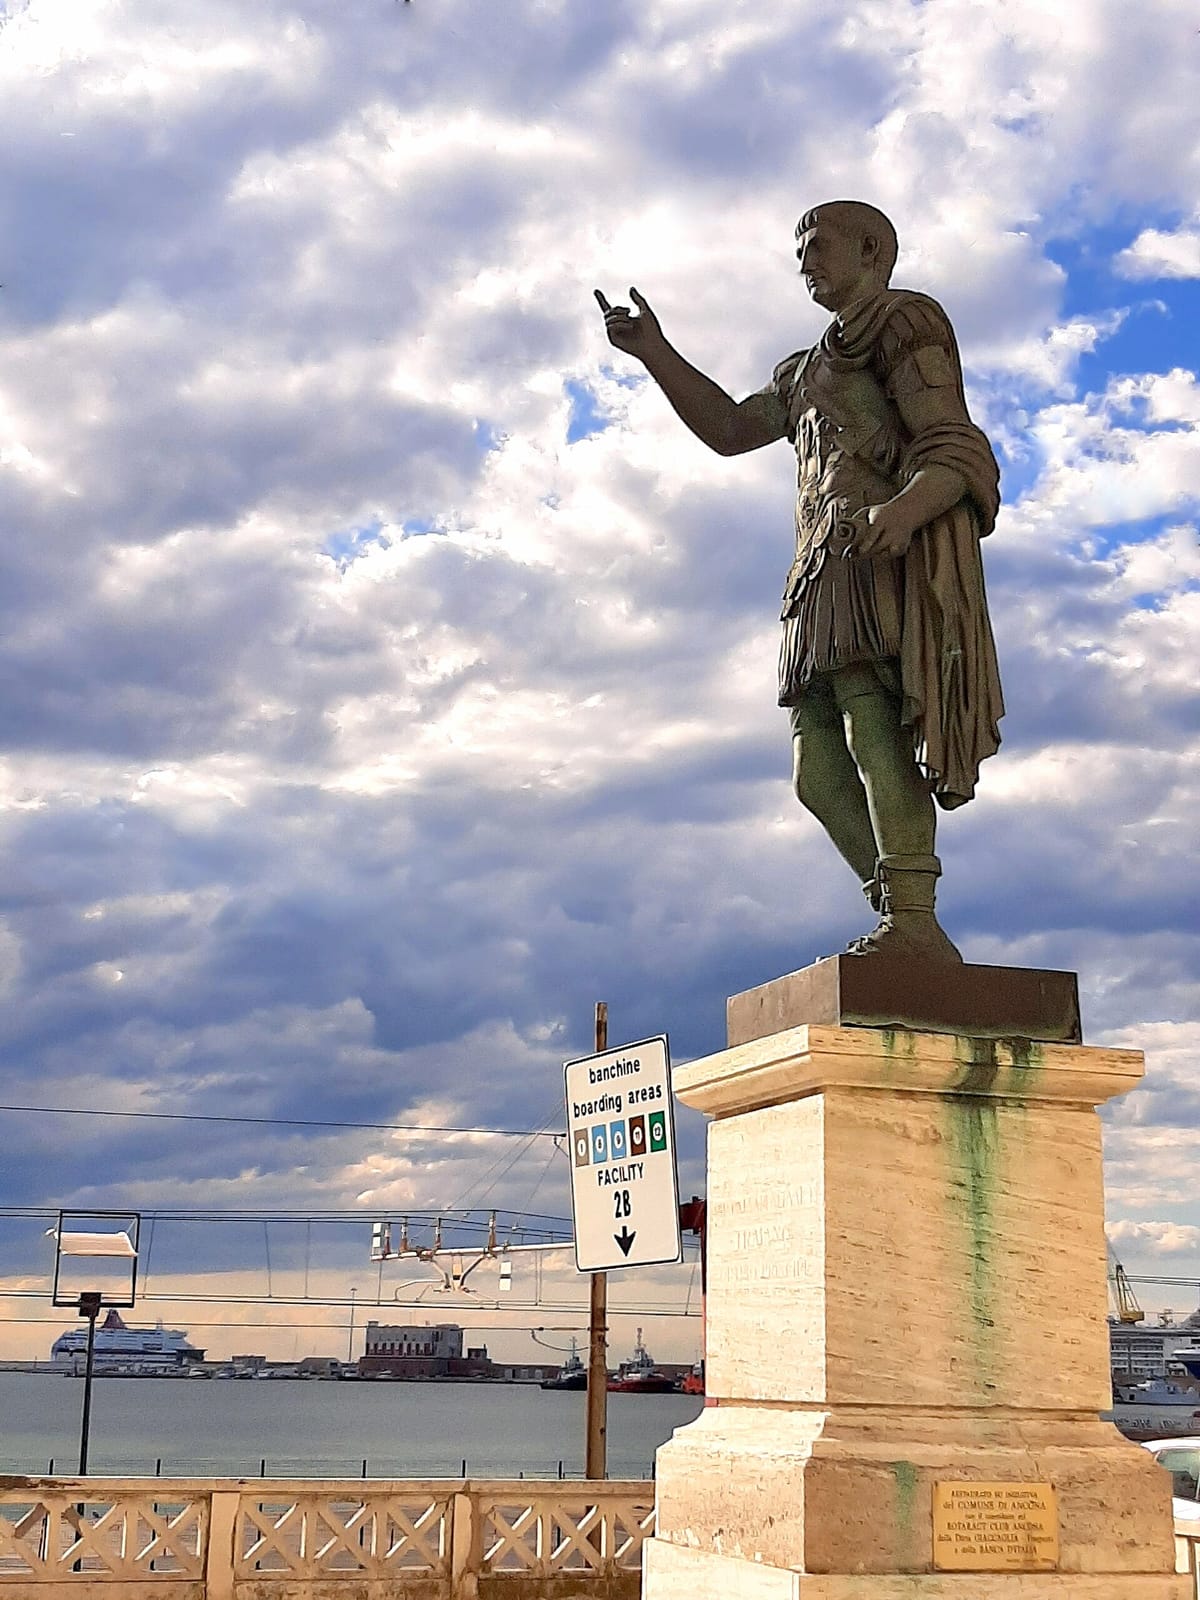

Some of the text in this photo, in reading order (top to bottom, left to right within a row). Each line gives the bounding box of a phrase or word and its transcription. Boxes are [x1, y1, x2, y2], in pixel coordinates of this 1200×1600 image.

[589, 1058, 641, 1084] banchine
[573, 1084, 662, 1118] boarding areas
[598, 1162, 644, 1187] FACILITY
[614, 1189, 631, 1219] 2B
[958, 1501, 994, 1510] COMUNE
[998, 1501, 1008, 1510] DI
[1011, 1501, 1047, 1511] ANCONA
